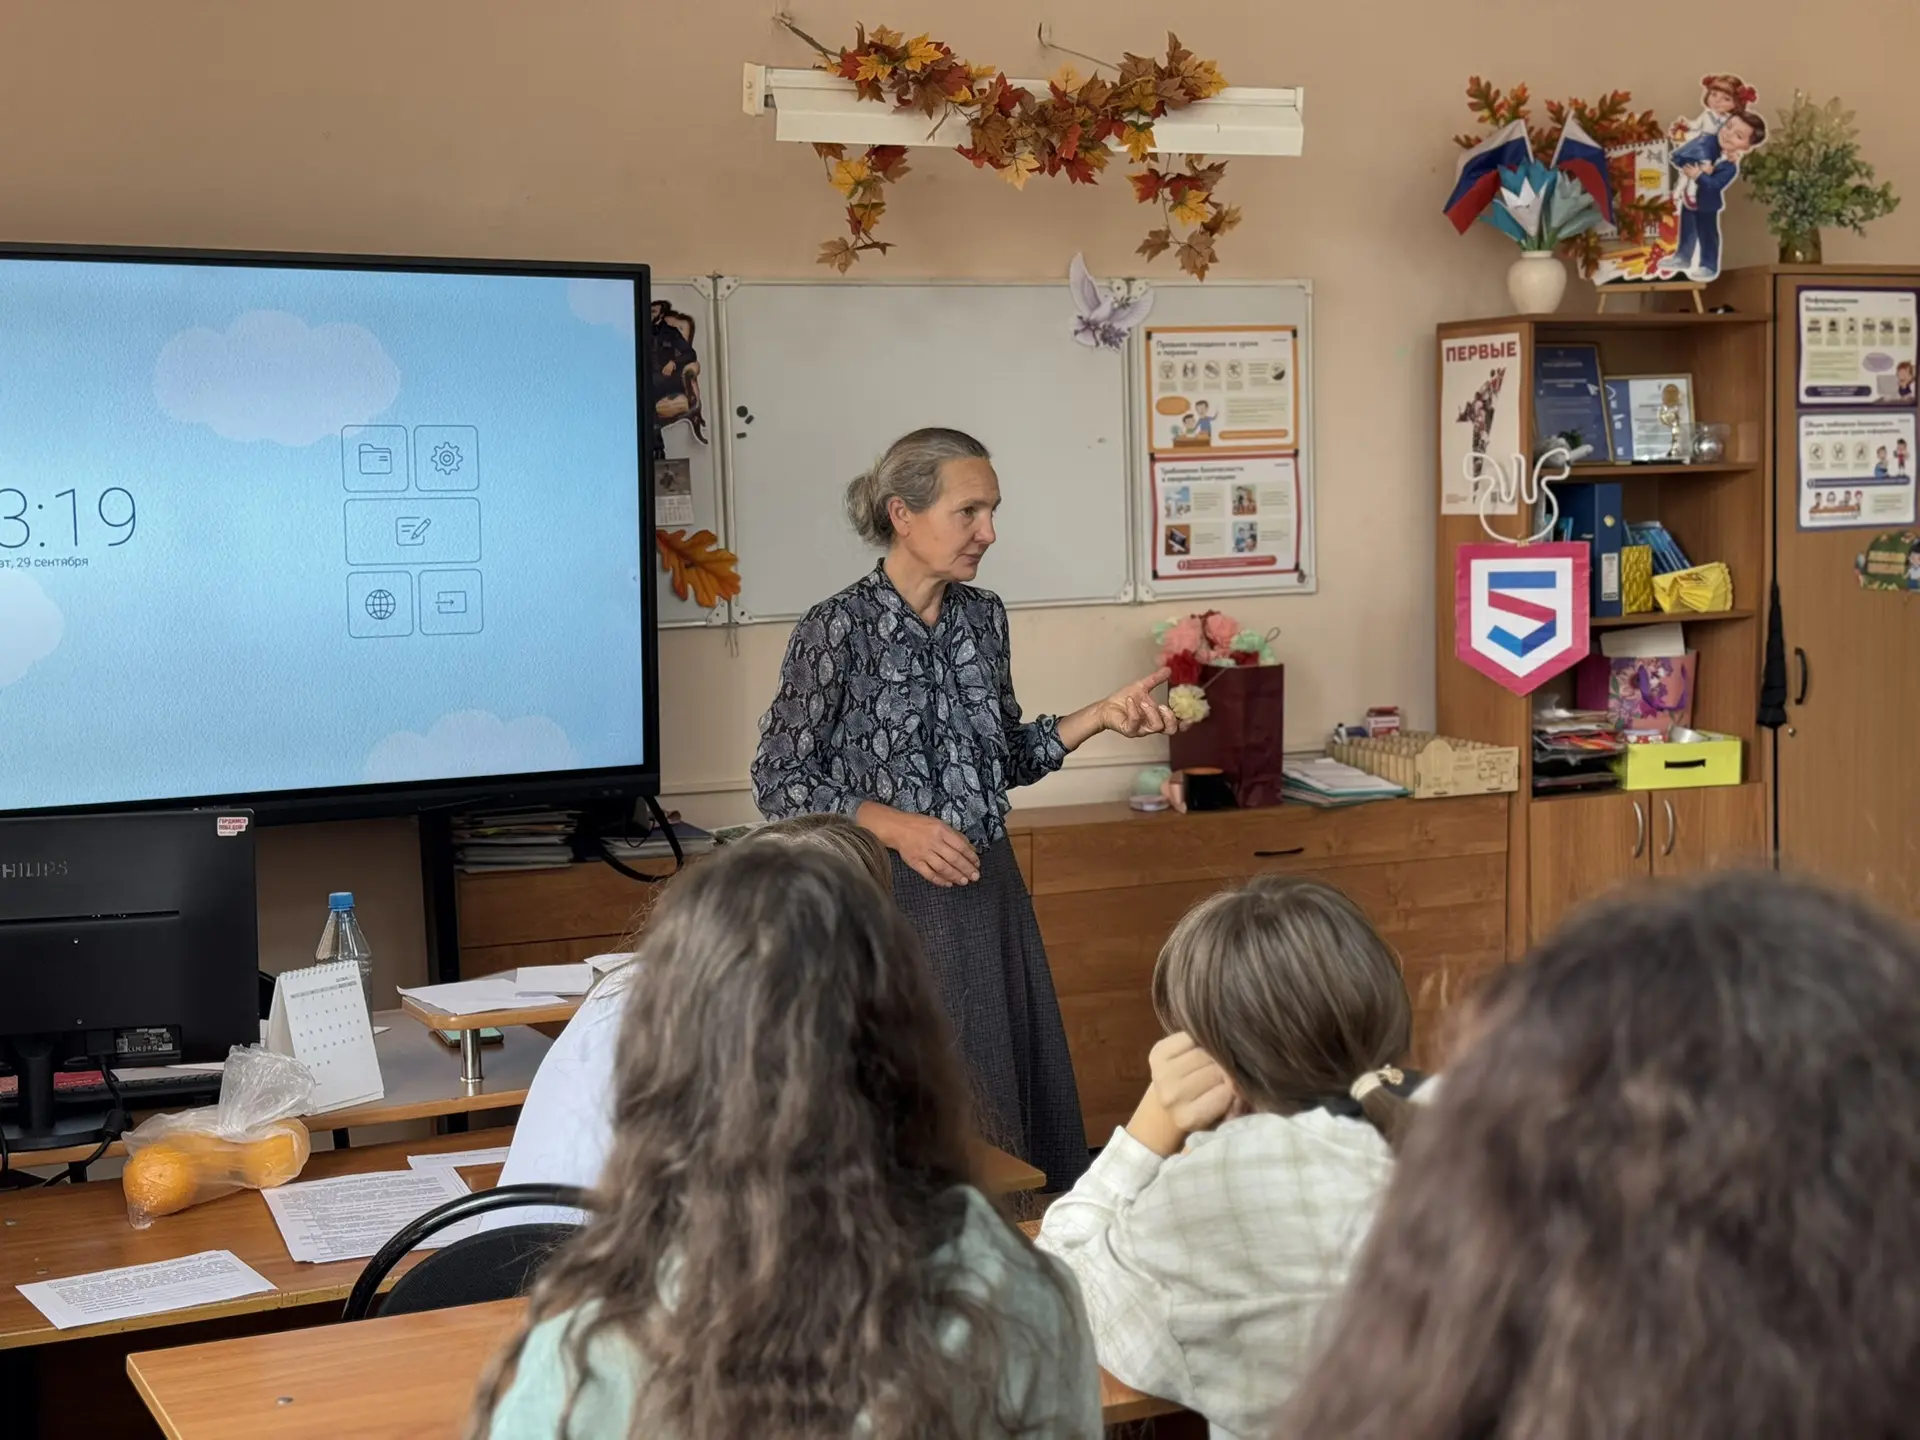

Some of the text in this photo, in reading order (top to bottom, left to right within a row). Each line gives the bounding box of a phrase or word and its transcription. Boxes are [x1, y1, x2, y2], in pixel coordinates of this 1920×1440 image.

[1446, 342, 1517, 362] ПЕРВЫЕ
[0, 487, 136, 549] 3:19
[16, 557, 31, 568] 29
[34, 556, 89, 569] сентября
[0, 861, 68, 878] HILIPS
